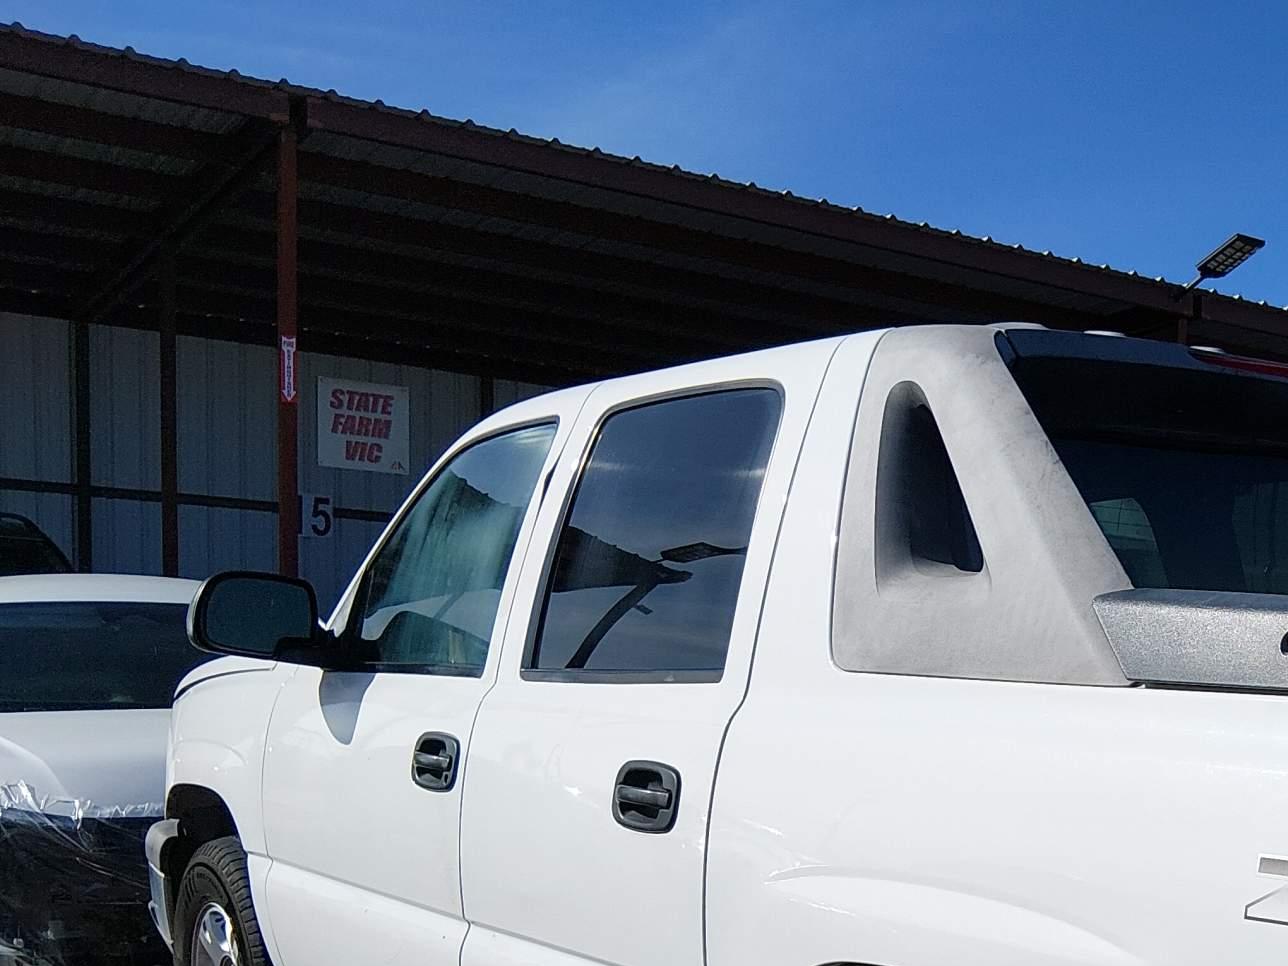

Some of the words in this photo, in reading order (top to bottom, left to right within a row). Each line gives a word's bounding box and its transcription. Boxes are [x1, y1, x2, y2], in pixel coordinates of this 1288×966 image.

[330, 388, 394, 416] STATE
[331, 413, 392, 440] FARM
[345, 439, 383, 464] VIC
